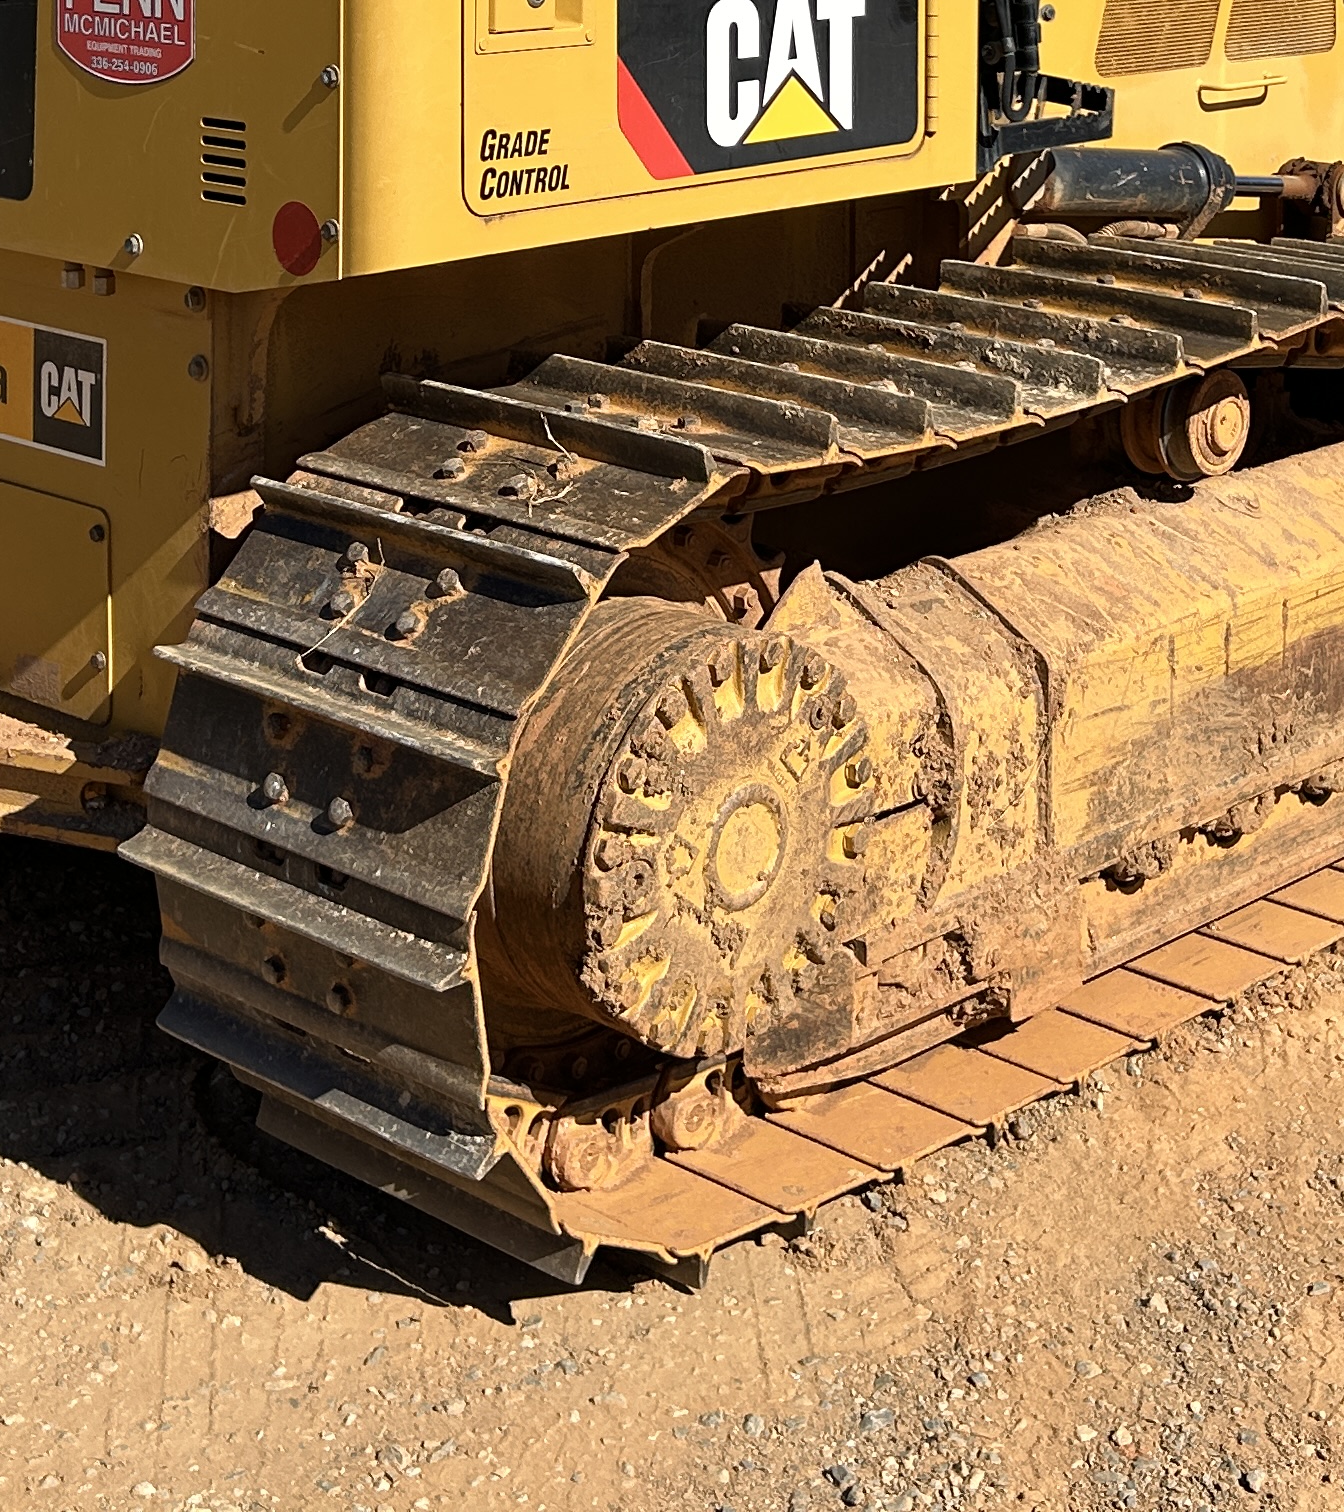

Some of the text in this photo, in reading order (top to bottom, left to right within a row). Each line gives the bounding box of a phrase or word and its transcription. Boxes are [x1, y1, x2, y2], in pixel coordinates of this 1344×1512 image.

[64, 13, 186, 46] MCMICHAEL
[86, 40, 162, 59] EQUIPMENT TRADING
[90, 55, 158, 76] 336-254-0906
[479, 128, 551, 162] GRADE
[479, 164, 570, 200] CONTROL
[40, 360, 96, 427] CAT
